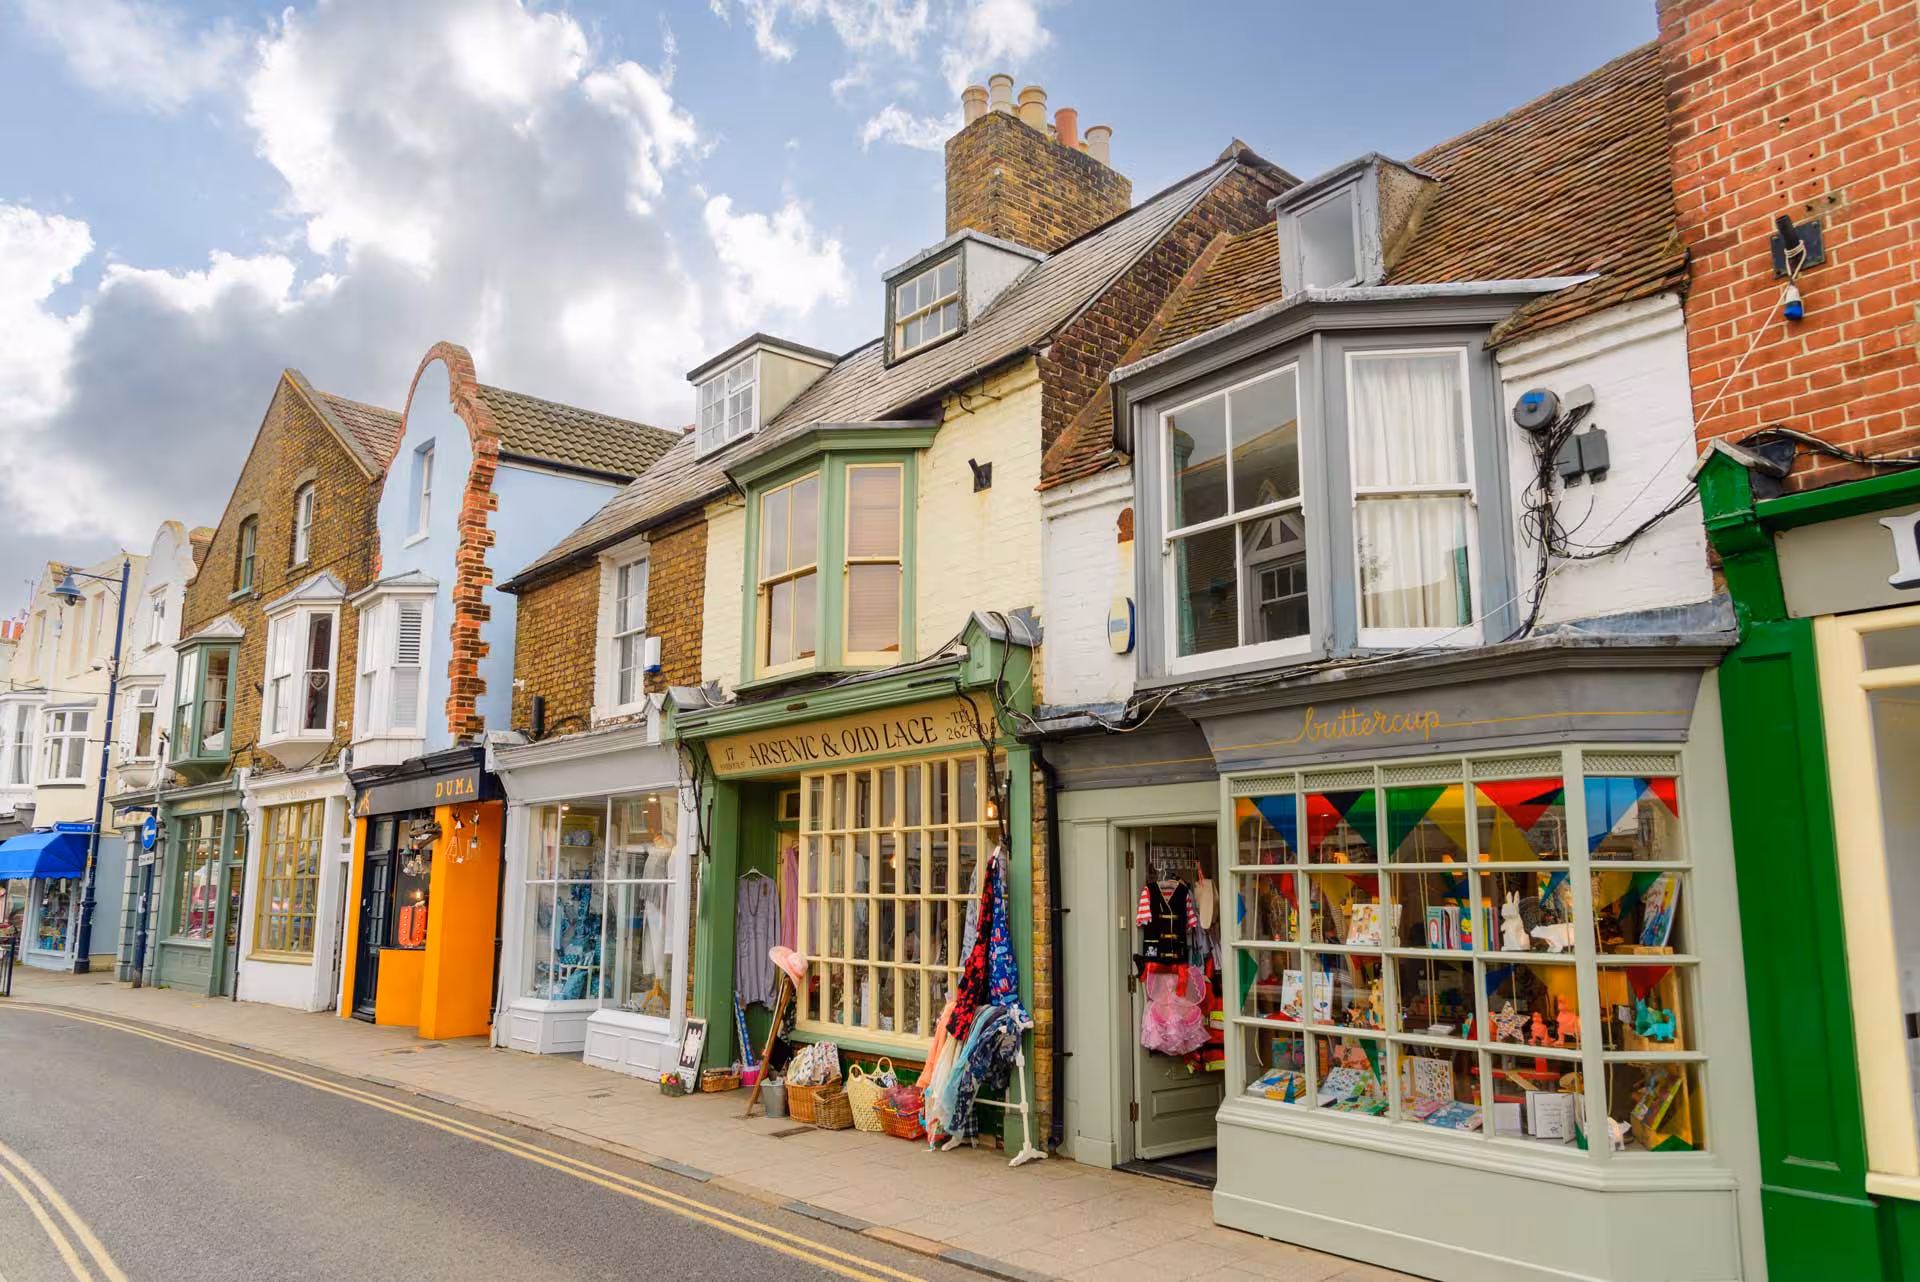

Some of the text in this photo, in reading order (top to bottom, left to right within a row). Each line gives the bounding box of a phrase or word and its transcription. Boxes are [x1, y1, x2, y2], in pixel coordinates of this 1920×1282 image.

[749, 716, 938, 767] ARSENIC & OLD LACE
[1303, 706, 1440, 743] buttercup
[435, 777, 474, 798] DUMA
